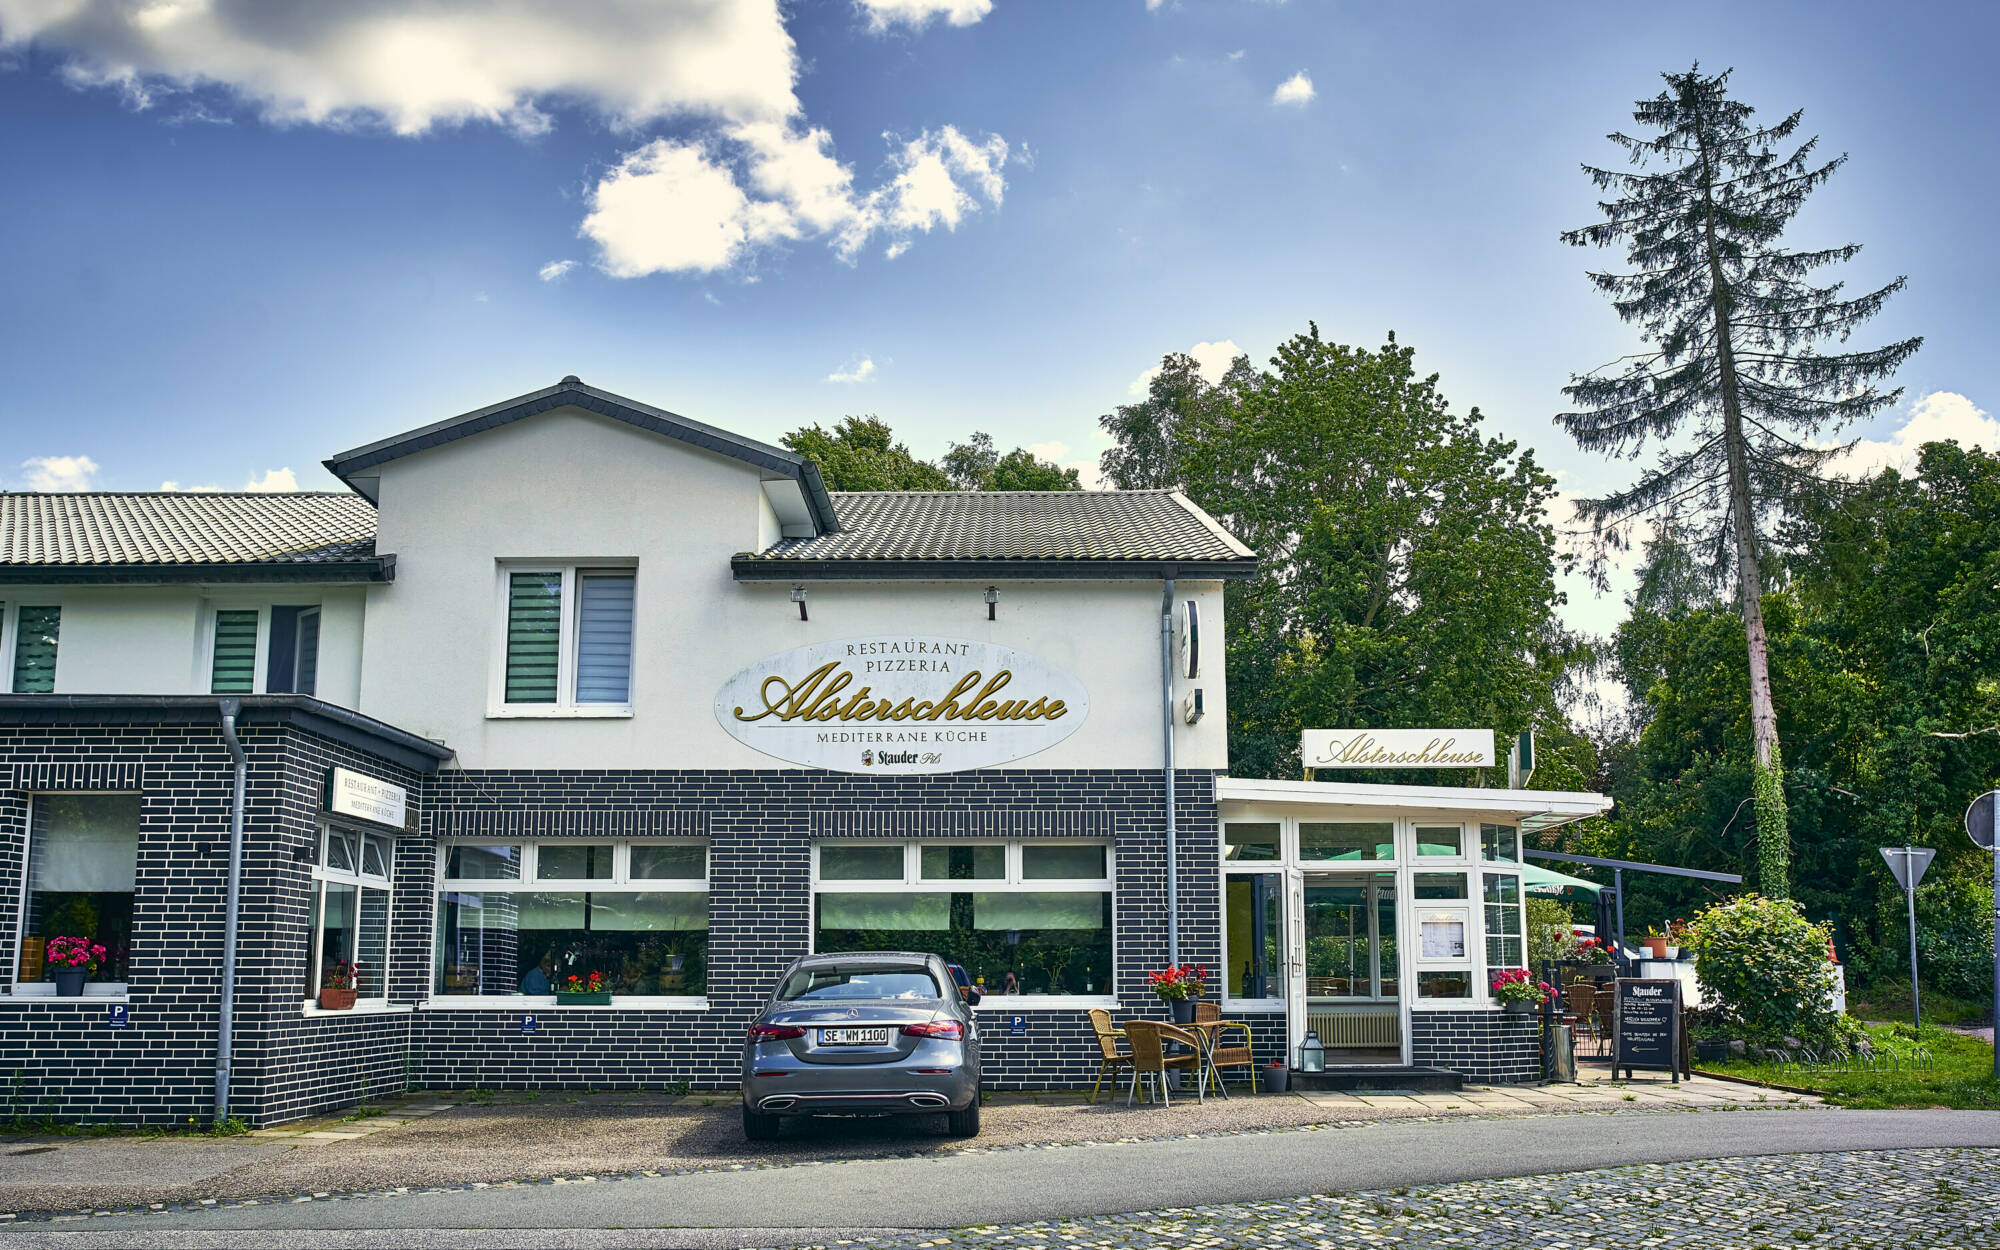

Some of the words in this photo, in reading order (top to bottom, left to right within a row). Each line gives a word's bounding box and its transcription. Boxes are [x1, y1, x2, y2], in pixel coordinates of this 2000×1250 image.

[847, 641, 970, 656] RESTAURANT
[866, 660, 951, 673] PIZZERIA
[734, 661, 1068, 722] Alsterschleuse
[816, 732, 928, 743] MEDITERRANE
[934, 730, 988, 743] KÜCHE
[1316, 733, 1485, 763] Alsterschleuse
[878, 750, 919, 766] Stauder
[920, 752, 943, 765] Pils
[345, 778, 377, 795] RESTAURANT
[1633, 986, 1662, 997] Stauder
[114, 1005, 124, 1017] P
[525, 1016, 533, 1026] P
[1014, 1016, 1022, 1026] P
[825, 1030, 838, 1041] SE
